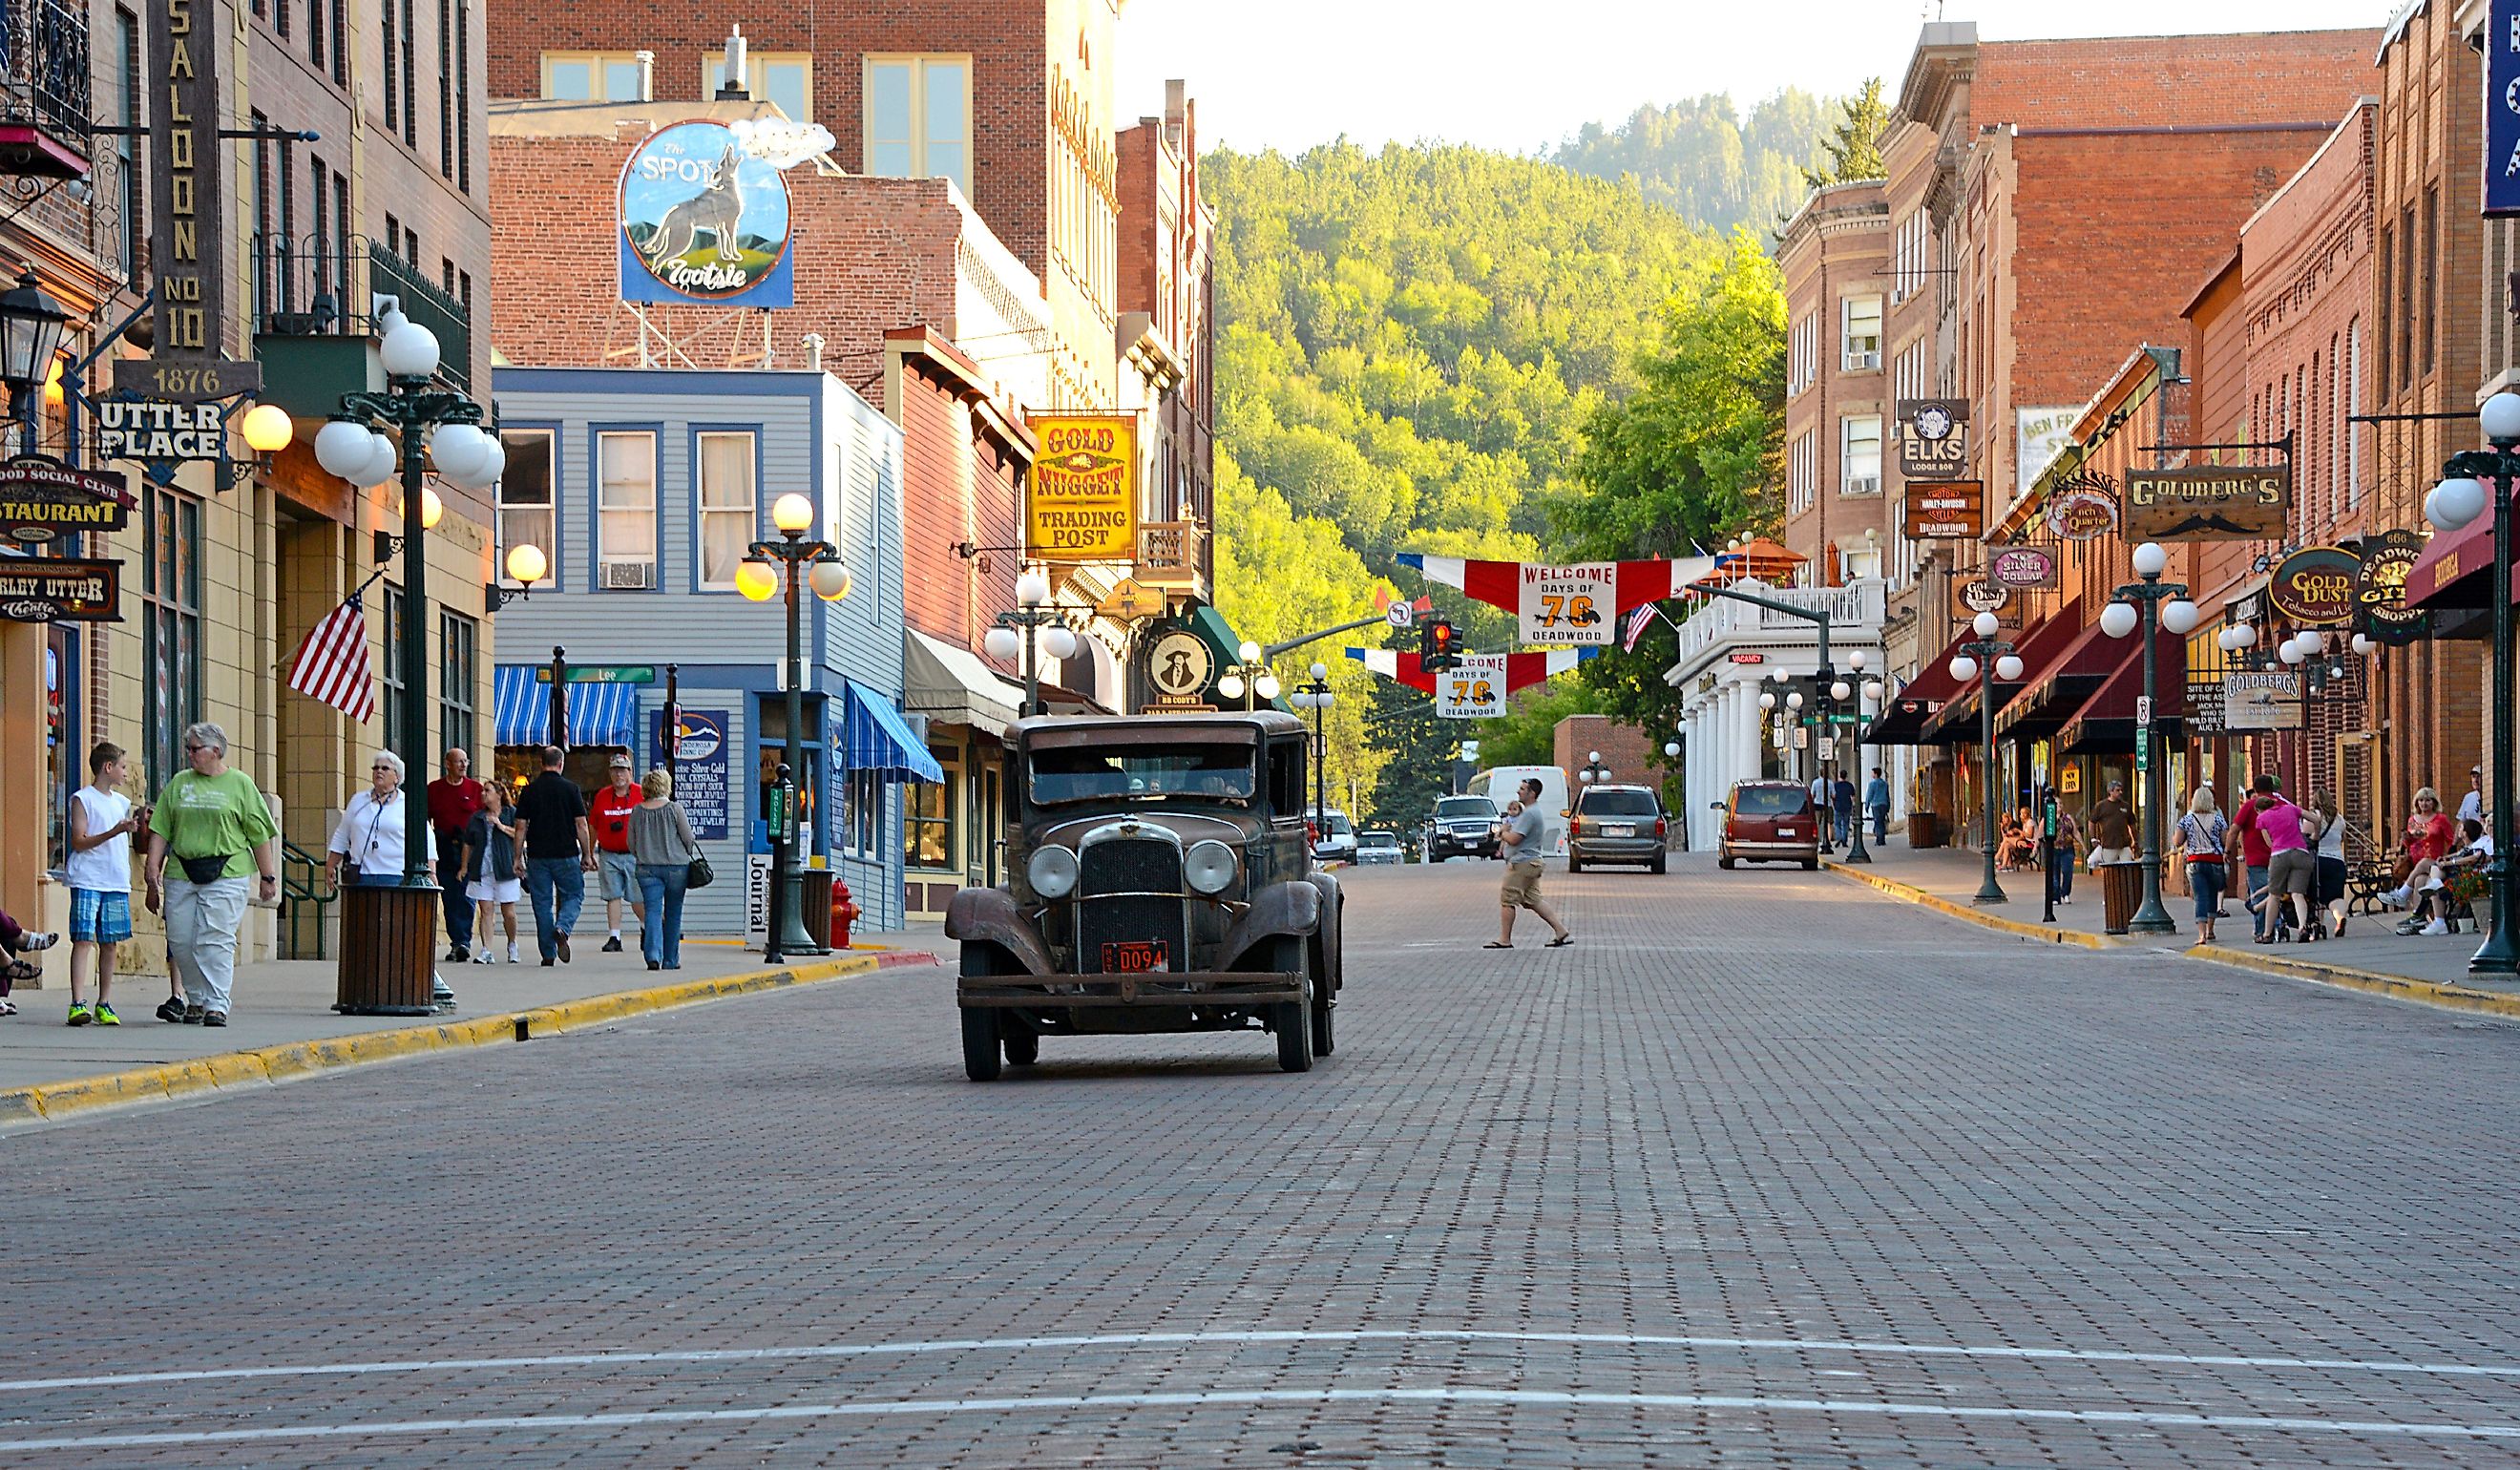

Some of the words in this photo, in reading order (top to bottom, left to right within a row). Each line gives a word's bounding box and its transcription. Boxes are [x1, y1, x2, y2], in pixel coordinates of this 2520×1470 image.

[664, 142, 685, 156] The
[164, 275, 200, 301] NO
[167, 307, 204, 347] 10
[153, 368, 220, 393] 1876
[100, 402, 221, 430] UTTER
[100, 430, 220, 458] PLACE
[1047, 428, 1115, 453] GOLD
[1904, 440, 1963, 461] ELKS
[30, 469, 79, 485] SOCIAL
[83, 478, 119, 498] CLUB
[1037, 465, 1124, 496] NUGGET
[2132, 474, 2280, 506] GOLDBERG'S
[0, 501, 117, 523] TAURANT
[1039, 511, 1126, 528] TRADING
[1053, 529, 1109, 547] POST
[1919, 522, 1968, 534] DEADWOOD
[2386, 534, 2407, 544] 666
[1524, 567, 1612, 585] WELCOME
[2002, 571, 2044, 581] DOLLAR
[2003, 561, 2042, 572] SILVER
[46, 578, 104, 602] UTTER
[1541, 584, 1574, 593] DAYS
[1579, 584, 1594, 593] OF
[2292, 572, 2348, 591] GOLD
[2281, 594, 2320, 617] Tobacco
[2320, 604, 2337, 617] and
[2303, 587, 2353, 603] DUST
[1542, 596, 1593, 628] 76
[1532, 631, 1602, 640] DEADWOOD
[1732, 655, 1761, 663] VACANCY
[598, 668, 617, 681] Lee
[1452, 681, 1491, 706] 76
[750, 857, 766, 934] Journal
[1120, 950, 1162, 970] D094
